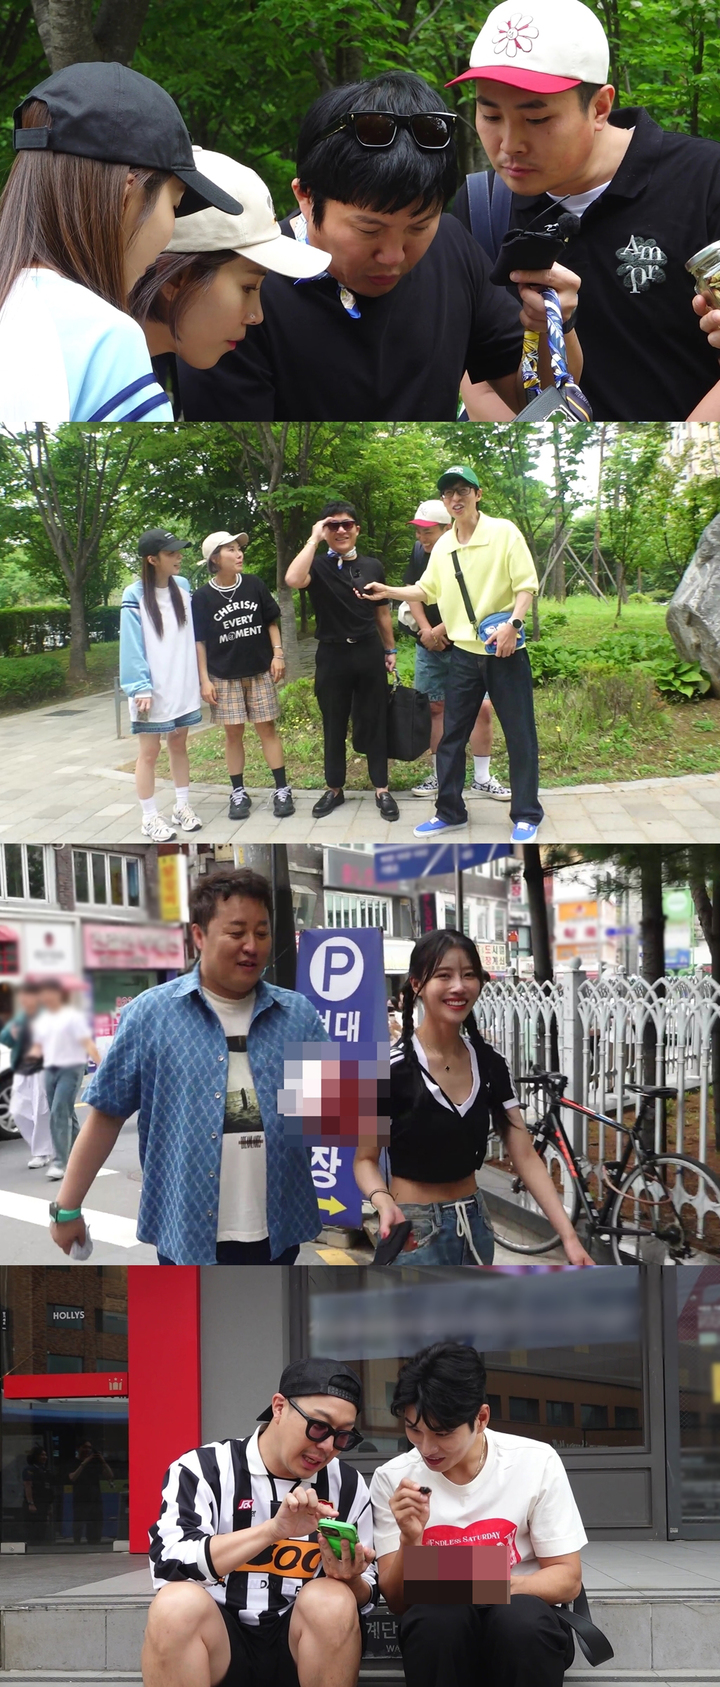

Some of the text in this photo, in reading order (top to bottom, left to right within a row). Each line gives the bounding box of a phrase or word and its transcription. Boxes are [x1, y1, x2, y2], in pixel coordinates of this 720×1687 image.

[620, 234, 664, 260] Am
[625, 264, 659, 293] pr
[213, 600, 258, 621] CHERISH
[222, 613, 253, 629] EVERY
[322, 945, 355, 992] P
[311, 1146, 342, 1189] 장
[53, 1311, 85, 1319] HOLLYS
[462, 1531, 500, 1543] SATURDAY
